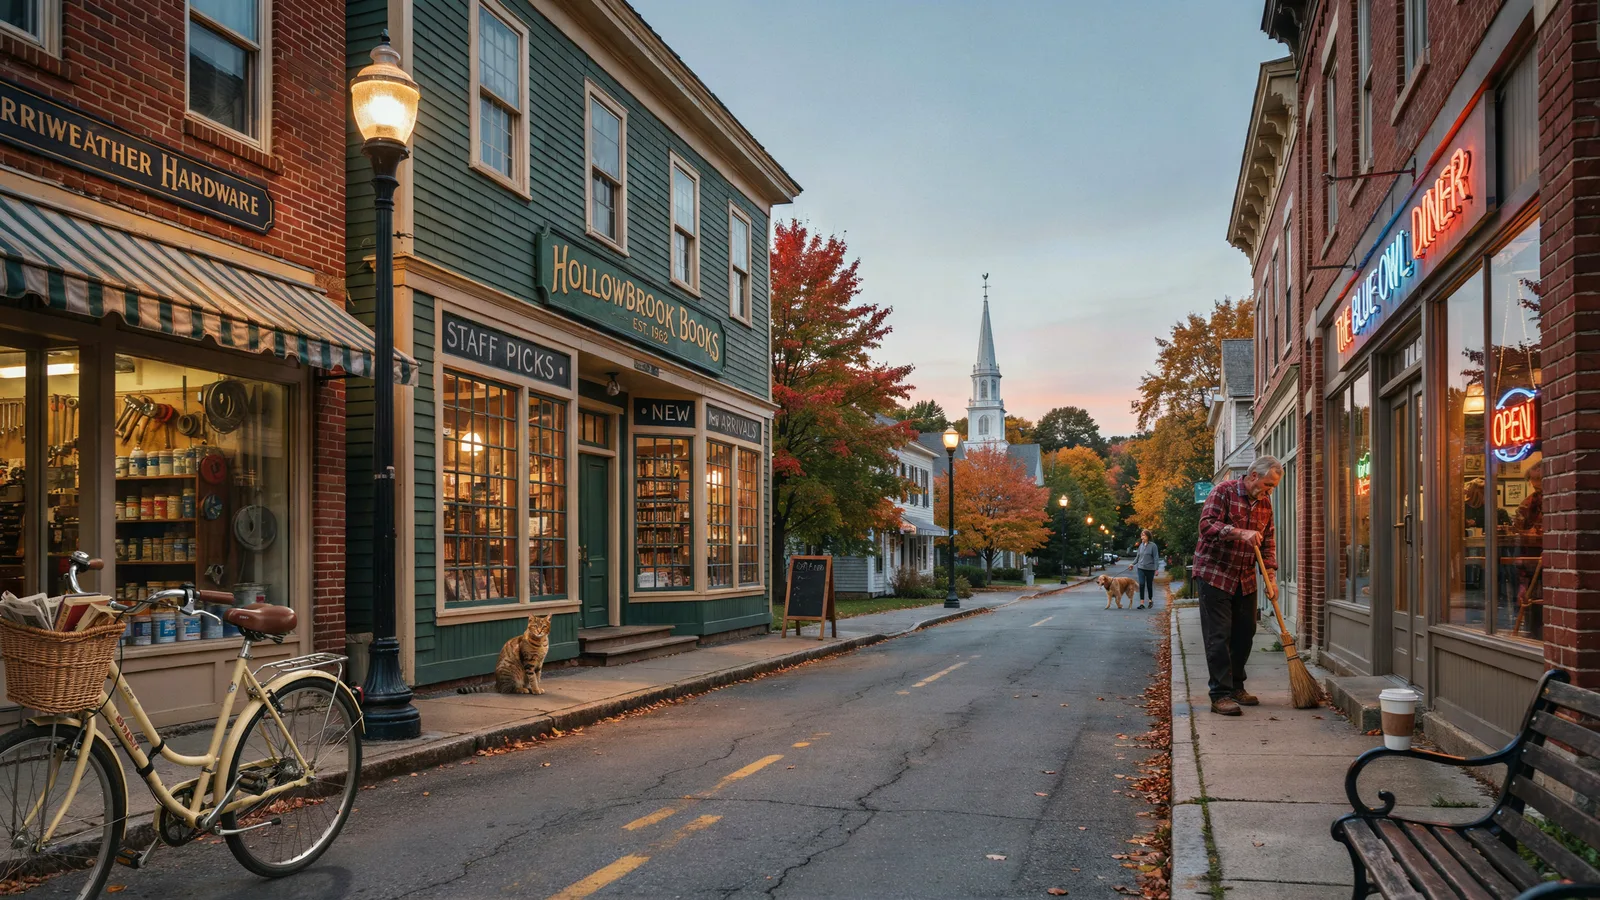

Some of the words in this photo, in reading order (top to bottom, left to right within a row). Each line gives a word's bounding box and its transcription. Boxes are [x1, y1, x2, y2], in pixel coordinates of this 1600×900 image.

[0, 96, 153, 176] RRIWEATHER
[161, 153, 259, 216] HARDWARE
[1335, 305, 1353, 353] THE
[1351, 268, 1381, 335] BLUE
[1379, 229, 1414, 300] OWL
[1411, 148, 1473, 260] DINER
[552, 244, 676, 337] HOLLOWBROOK
[679, 306, 719, 363] BOOKS
[447, 321, 498, 361] STAFF
[506, 342, 554, 380] PICKS
[633, 317, 648, 336] EST.
[651, 326, 669, 344] 1962
[652, 404, 690, 422] NEW
[721, 415, 757, 439] ARRIVALS
[1494, 403, 1531, 446] OPEN
